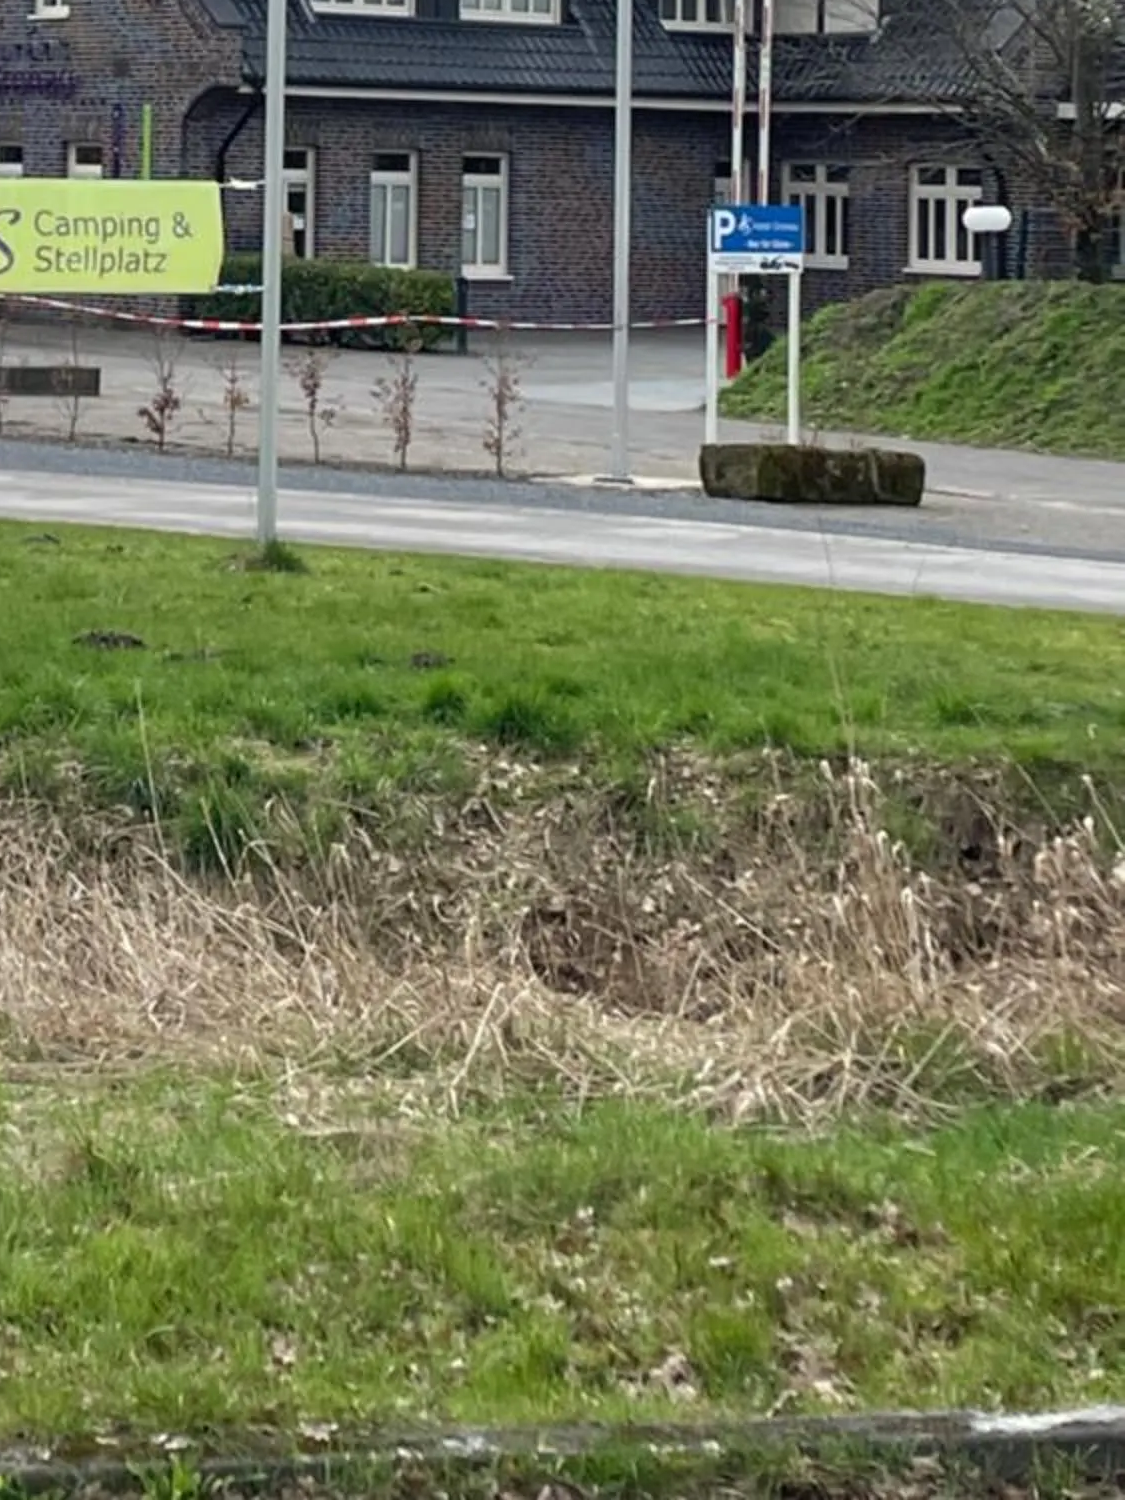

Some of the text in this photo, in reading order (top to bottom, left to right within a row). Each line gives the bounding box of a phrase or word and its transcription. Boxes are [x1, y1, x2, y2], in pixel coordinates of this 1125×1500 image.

[32, 209, 194, 246] Camping &
[714, 208, 737, 251] P
[32, 245, 169, 279] Stellplatz
